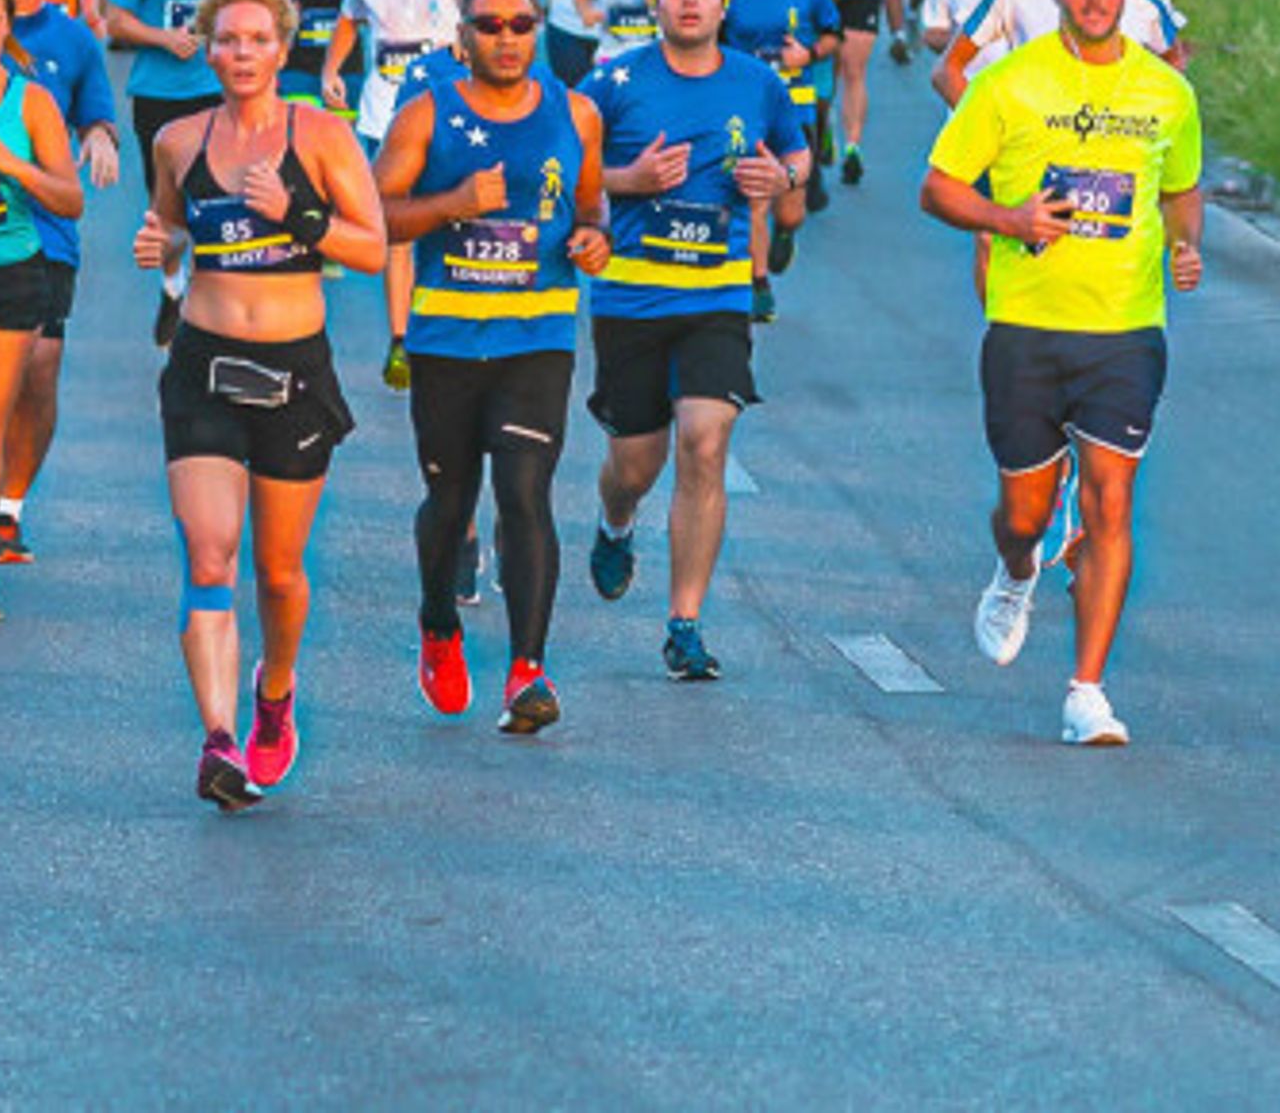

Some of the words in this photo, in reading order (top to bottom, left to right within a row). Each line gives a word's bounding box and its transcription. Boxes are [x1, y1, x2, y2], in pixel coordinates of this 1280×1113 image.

[221, 218, 253, 243] 85
[667, 219, 711, 243] 269
[463, 238, 521, 262] 1228
